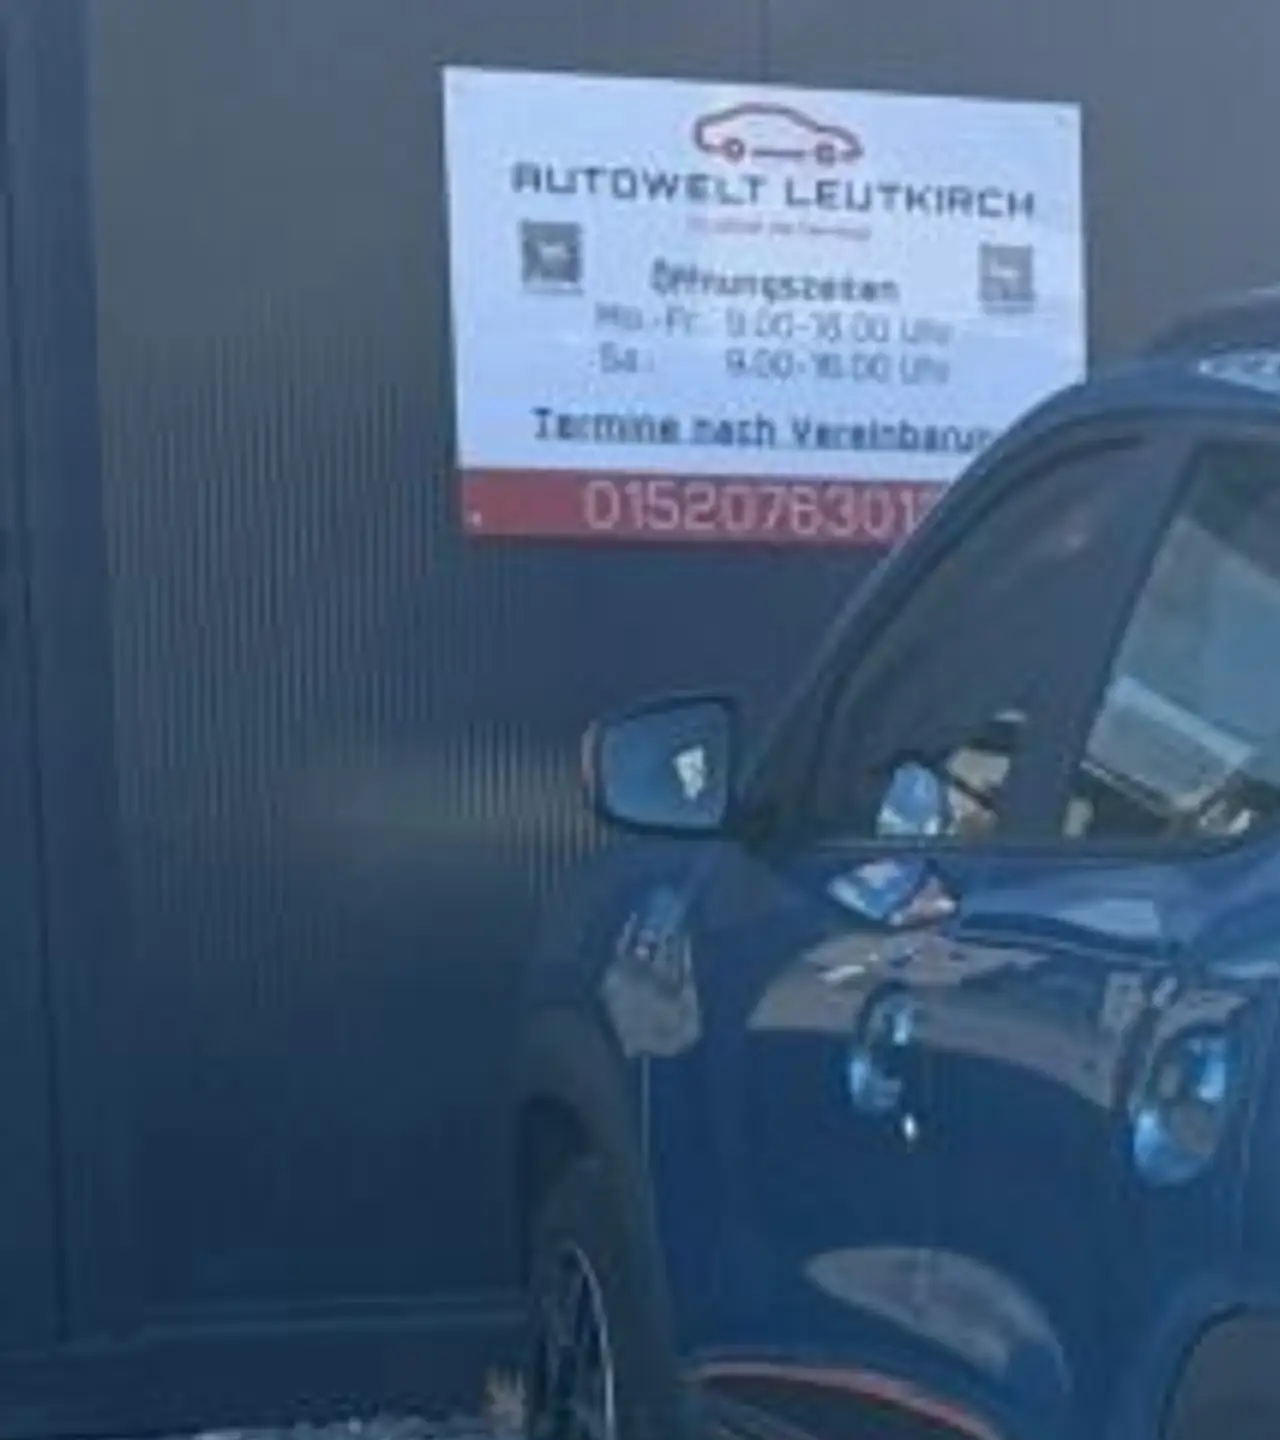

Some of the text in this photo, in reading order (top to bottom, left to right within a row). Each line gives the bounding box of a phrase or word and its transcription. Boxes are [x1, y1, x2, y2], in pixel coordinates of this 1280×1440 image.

[511, 162, 1035, 222] AUTOWELT LEUTKIRCH
[531, 408, 1000, 454] Termine nach Vereinbarun
